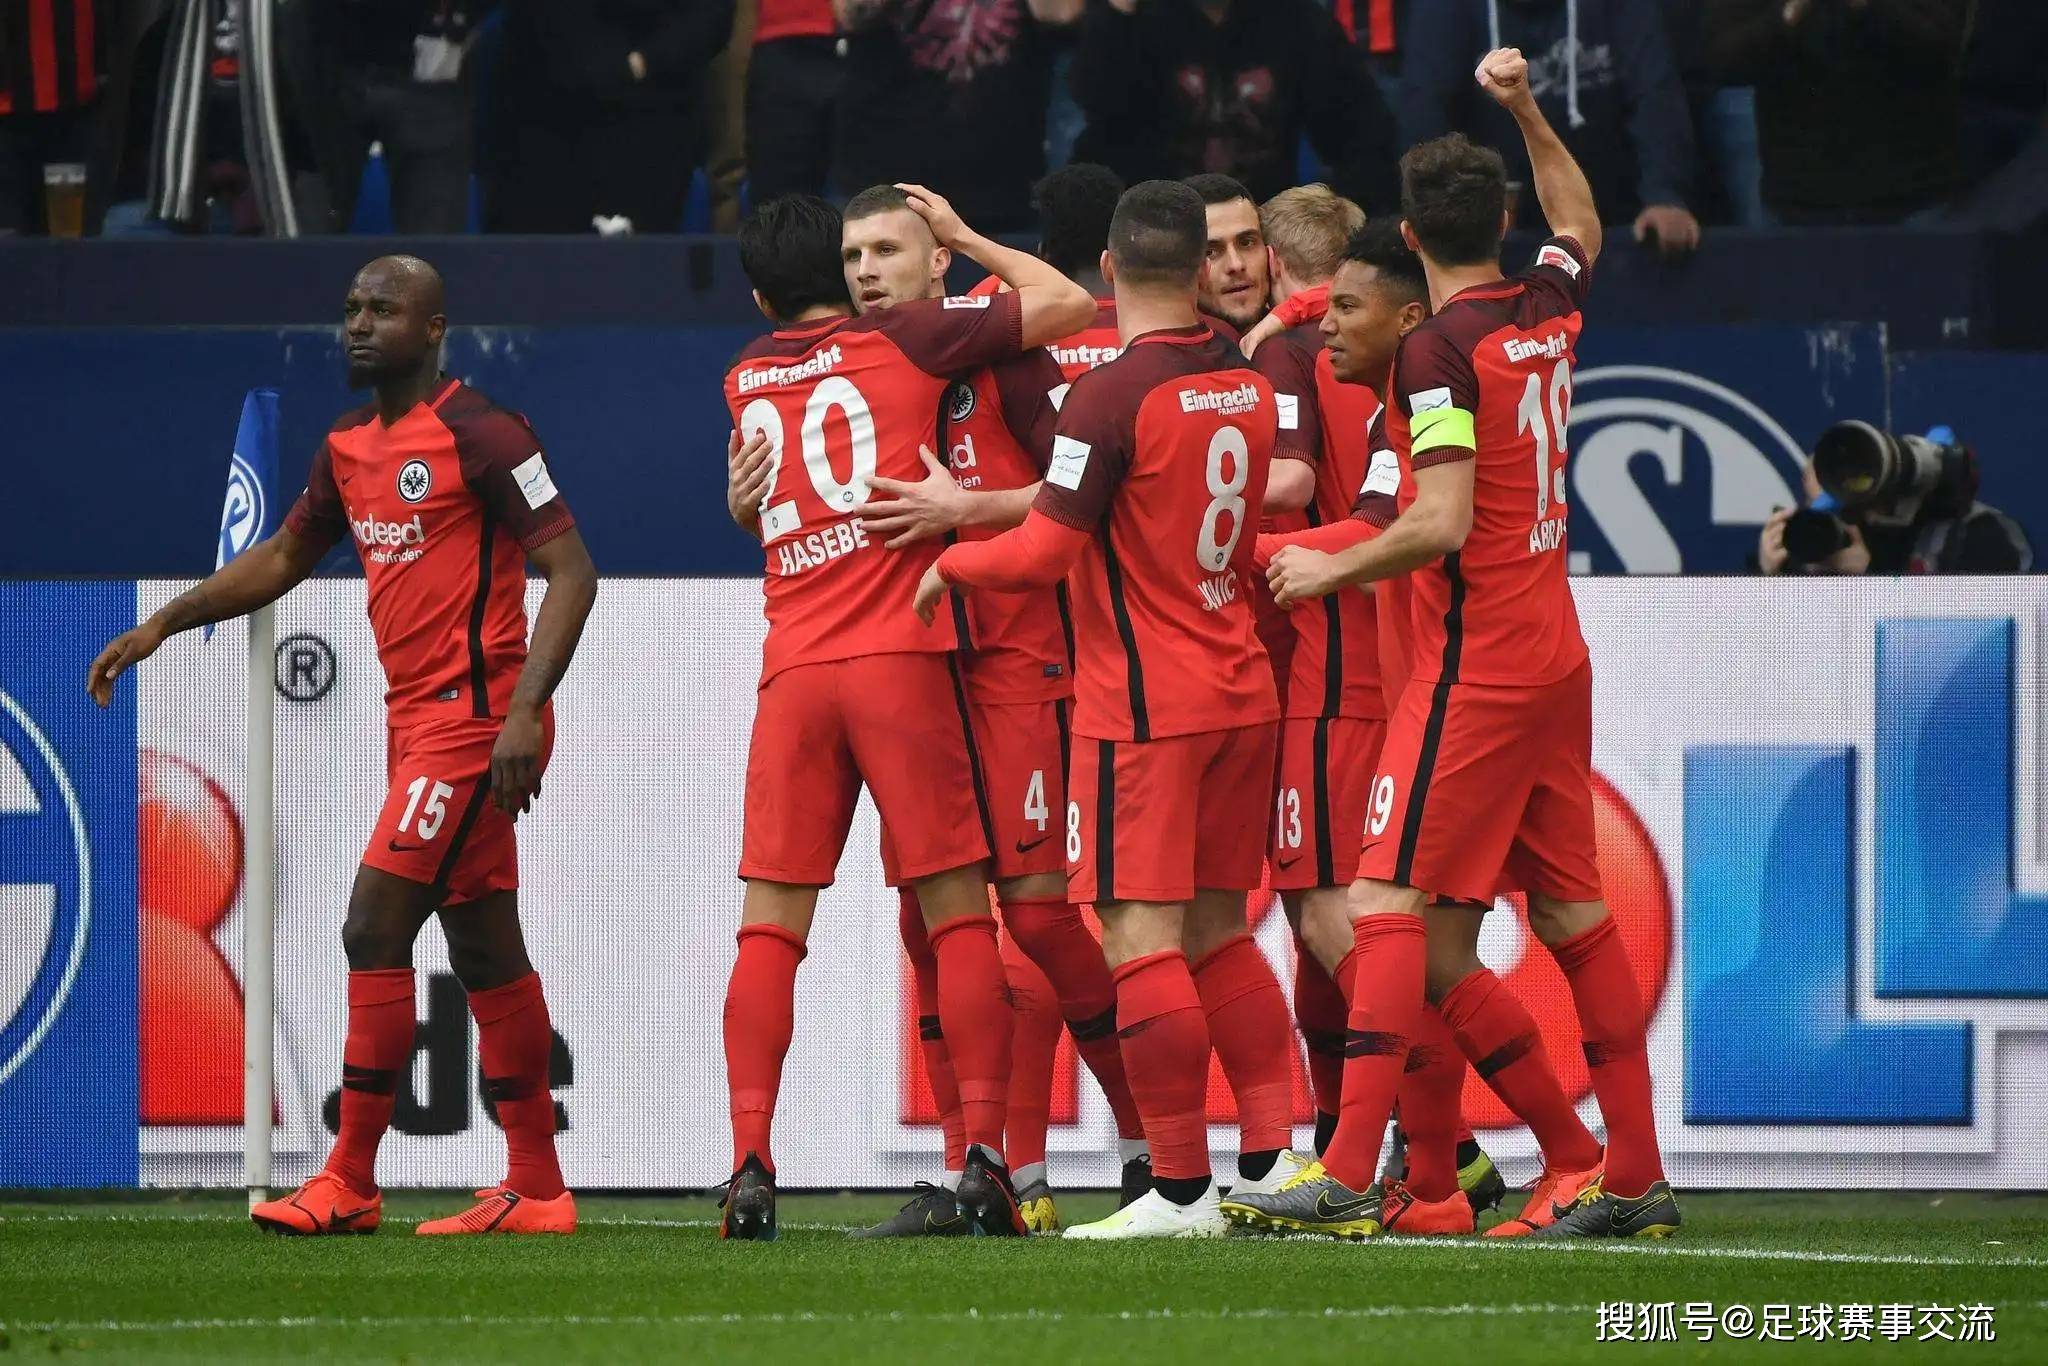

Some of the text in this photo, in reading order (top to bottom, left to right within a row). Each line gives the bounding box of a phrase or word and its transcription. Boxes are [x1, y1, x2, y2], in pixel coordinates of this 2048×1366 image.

[738, 344, 843, 393] Eintracht
[1178, 383, 1260, 413] Eintracht
[1218, 404, 1256, 417] FRANKFURT
[1517, 357, 1572, 521] 19
[741, 376, 877, 545] 20
[349, 505, 425, 547] indeed
[1196, 425, 1249, 573] 8
[370, 548, 385, 563] Jobs
[778, 517, 870, 577] HASEBE
[1529, 518, 1567, 554] ABRA
[397, 775, 454, 841] 15
[1023, 769, 1049, 831] 4
[1277, 787, 1302, 849] 13
[1066, 801, 1082, 863] 8
